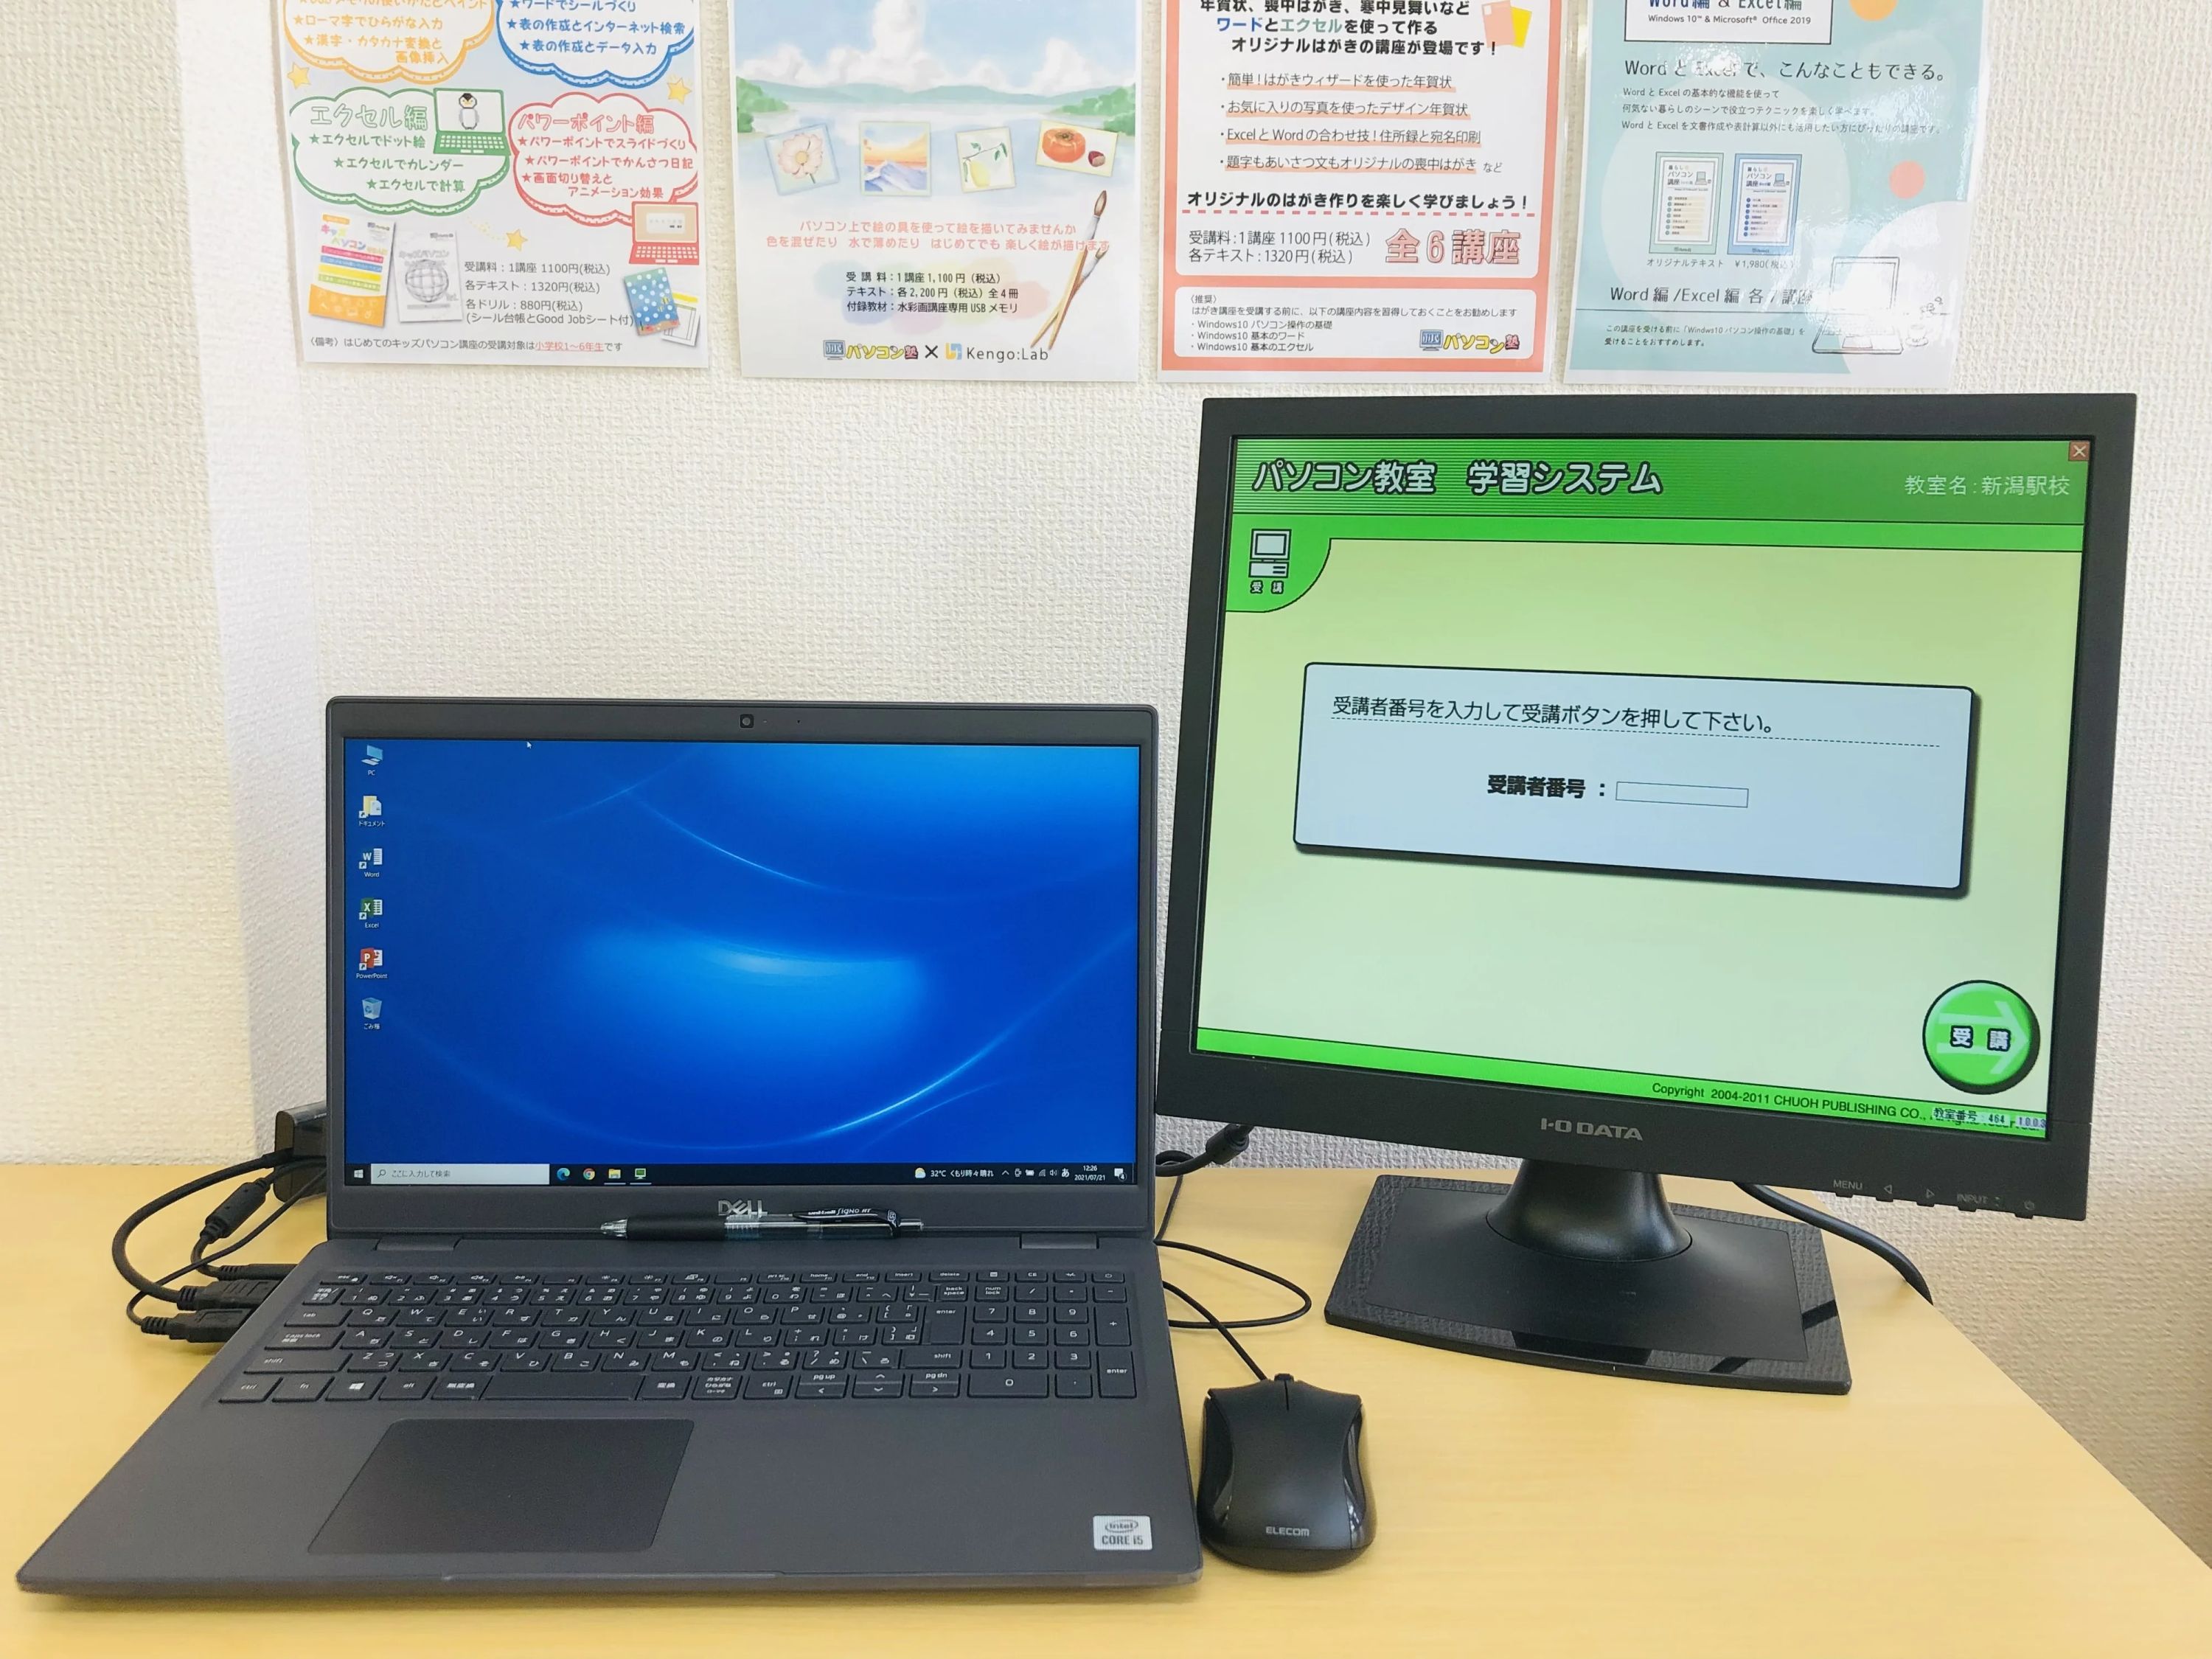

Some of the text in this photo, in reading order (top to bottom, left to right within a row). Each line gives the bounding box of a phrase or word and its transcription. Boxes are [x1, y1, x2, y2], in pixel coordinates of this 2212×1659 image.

[305, 15, 443, 30] ローマ字でひらがな入力
[519, 18, 686, 35] 表の作成とインターネット検索
[1217, 18, 1438, 35] ワードとエクセルを使って作る
[1648, 15, 1685, 23] Windows
[1762, 16, 1788, 24] Office
[532, 40, 657, 55] 表の作成とデータ入力
[395, 51, 449, 64] 画像挿入
[1625, 60, 1667, 76] Word
[310, 103, 428, 131] エクセル編
[518, 112, 655, 134] パワーポイント編
[322, 134, 425, 148] エクセルでドット絵
[529, 136, 686, 150] パワーポイントでスライドづくり
[347, 157, 464, 172] エクセルでカレンダー
[537, 156, 694, 170] パワーポイントでかんさつ日記
[379, 178, 466, 193] エクセルで計算
[533, 173, 613, 185] 画面切り替えと
[568, 187, 664, 199] アニメーション効果
[800, 220, 1077, 235] パソコン上で絵の具を使って絵を描いてみませんか
[766, 235, 1110, 251] 色を混ぜたり 水で薄めたり はじめてでも 楽しく絵が描けます
[1197, 320, 1333, 330] Windows10 パソコン操作の基礎
[1197, 331, 1305, 341] Windows10 基本のワード
[1197, 342, 1315, 352] Windows10 基本のエクセル
[966, 347, 1049, 363] Kengo:Lab
[1253, 459, 1663, 496] パソコン教室 学習システム
[1332, 695, 1773, 734] 受講者番号を入力して受講ボタンを押して下さい。
[1652, 1082, 1705, 1099] Copyright
[1710, 1088, 1770, 1105] 2004-2011
[1773, 1094, 1820, 1110] CHUOH
[1822, 1099, 1896, 1117] PUBLISHING
[1576, 1121, 1644, 1141] DATA
[1062, 1168, 1070, 1178] あ
[1074, 1173, 1106, 1182] 2021/07/21
[1832, 1179, 1863, 1192] MENU
[718, 1200, 768, 1217] DELL
[1265, 1526, 1310, 1537] ELECOM
[1102, 1534, 1144, 1545] CORE i5
